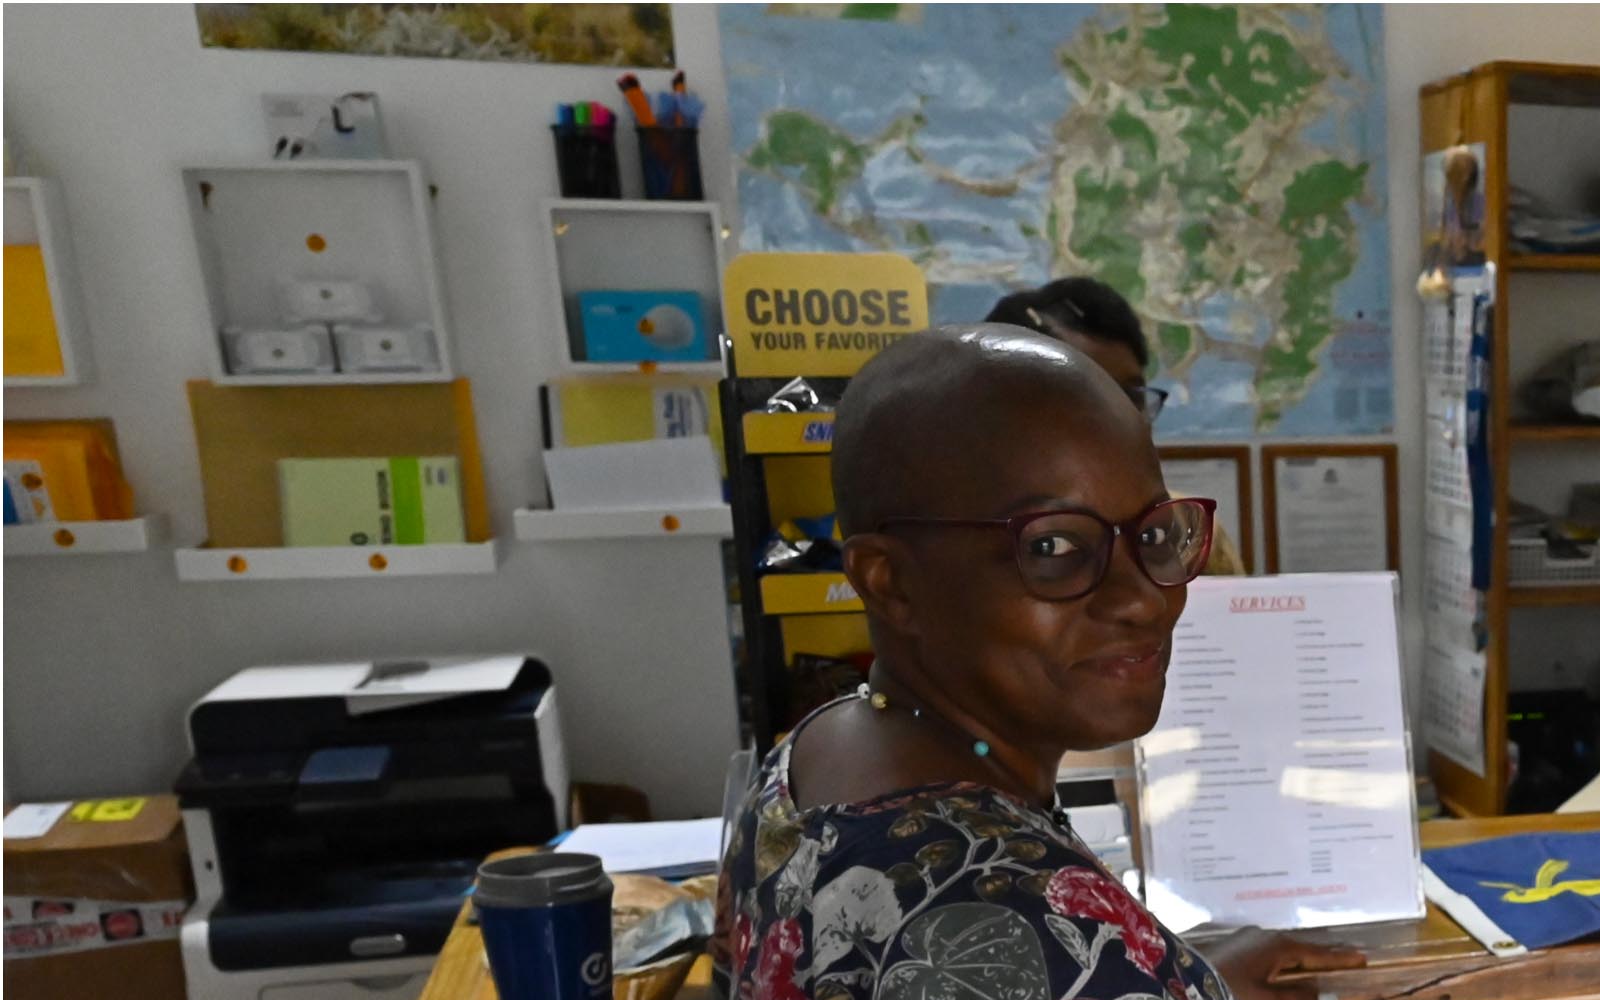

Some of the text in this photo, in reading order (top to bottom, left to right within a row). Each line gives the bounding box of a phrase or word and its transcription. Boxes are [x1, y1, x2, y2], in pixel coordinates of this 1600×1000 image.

[745, 288, 911, 326] CHOOSE
[750, 331, 903, 351] YOUR FAVORIT
[1230, 595, 1306, 610] SERVICES
